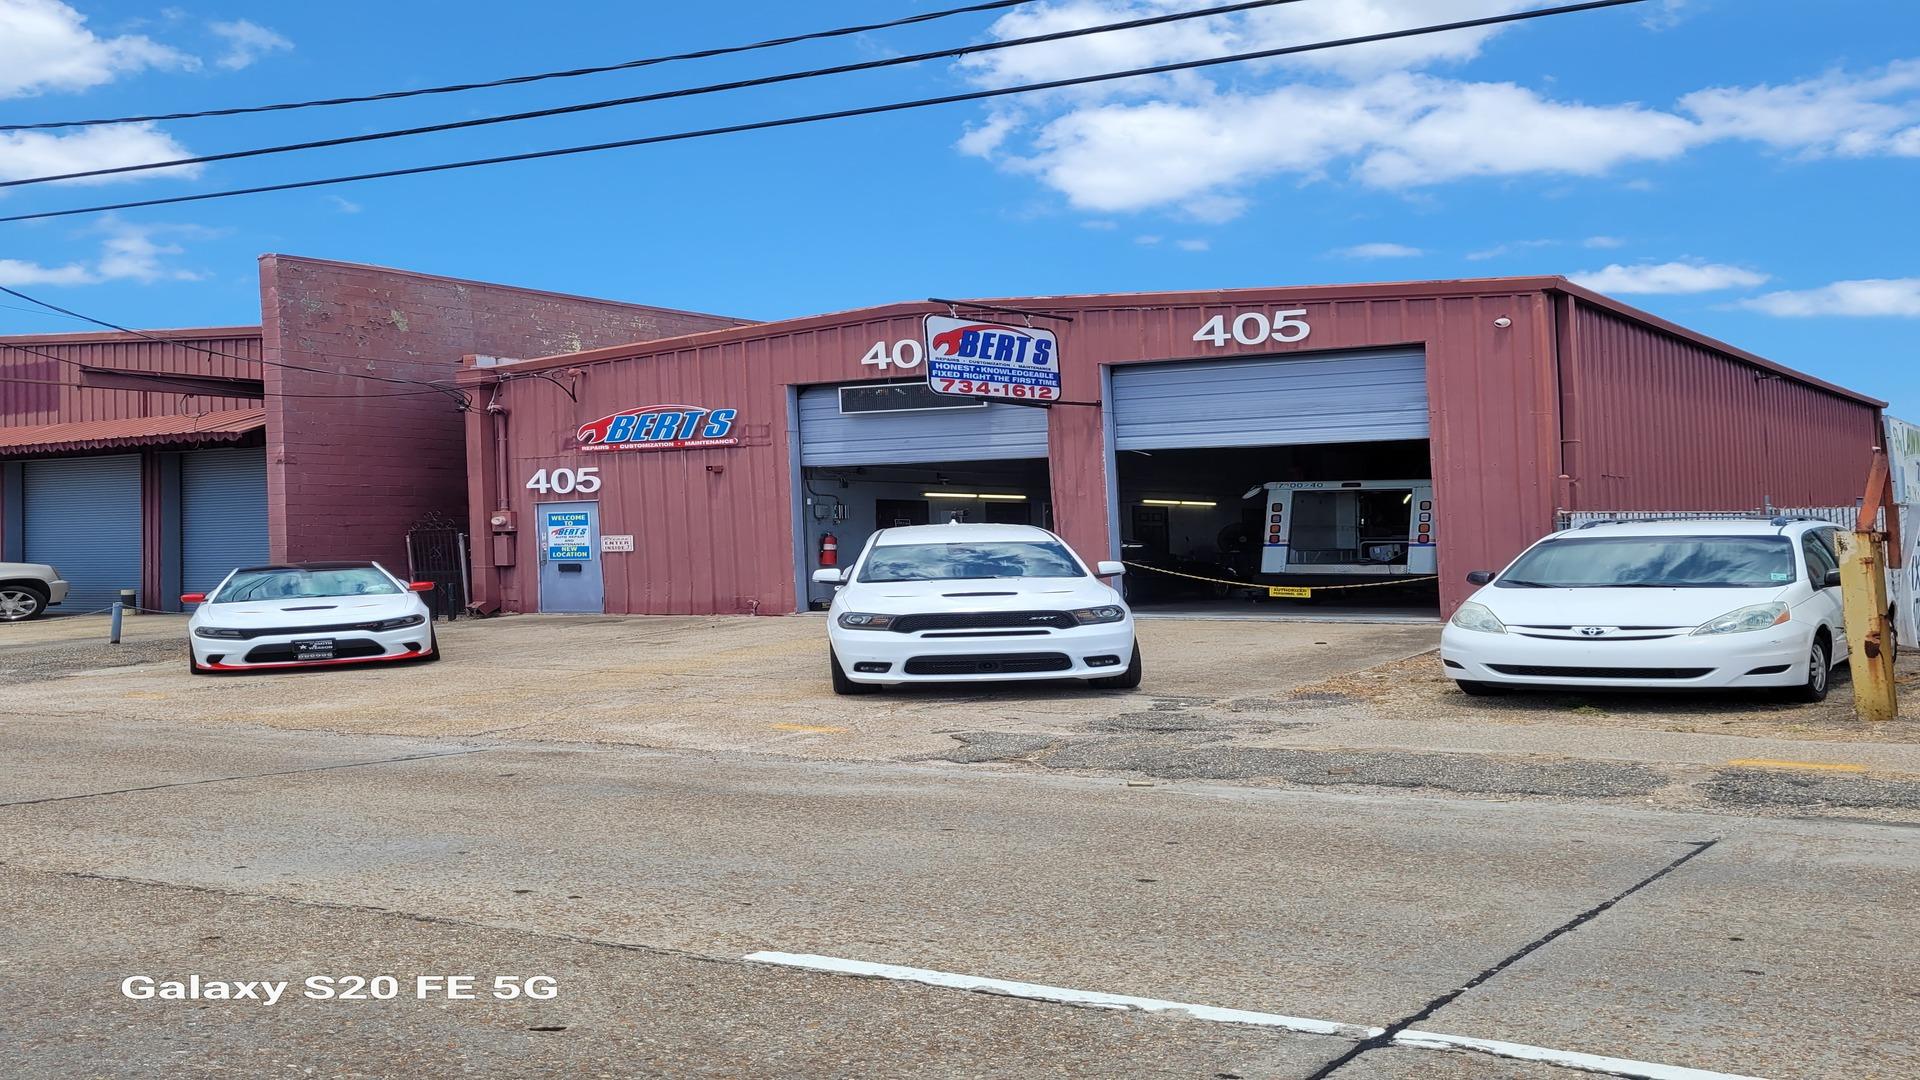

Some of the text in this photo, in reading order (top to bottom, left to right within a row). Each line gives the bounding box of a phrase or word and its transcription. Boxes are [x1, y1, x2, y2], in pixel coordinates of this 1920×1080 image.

[1193, 309, 1310, 346] 405
[861, 339, 927, 369] 40
[932, 369, 960, 378] FIXED
[963, 372, 991, 381] RIGHT
[1012, 376, 1037, 385] FIRST
[935, 362, 1054, 380] HONEST KNOWLEDGEABLE
[939, 379, 1052, 399] 734-1612
[684, 439, 734, 447] MAINTENANCE
[526, 467, 601, 494] 405
